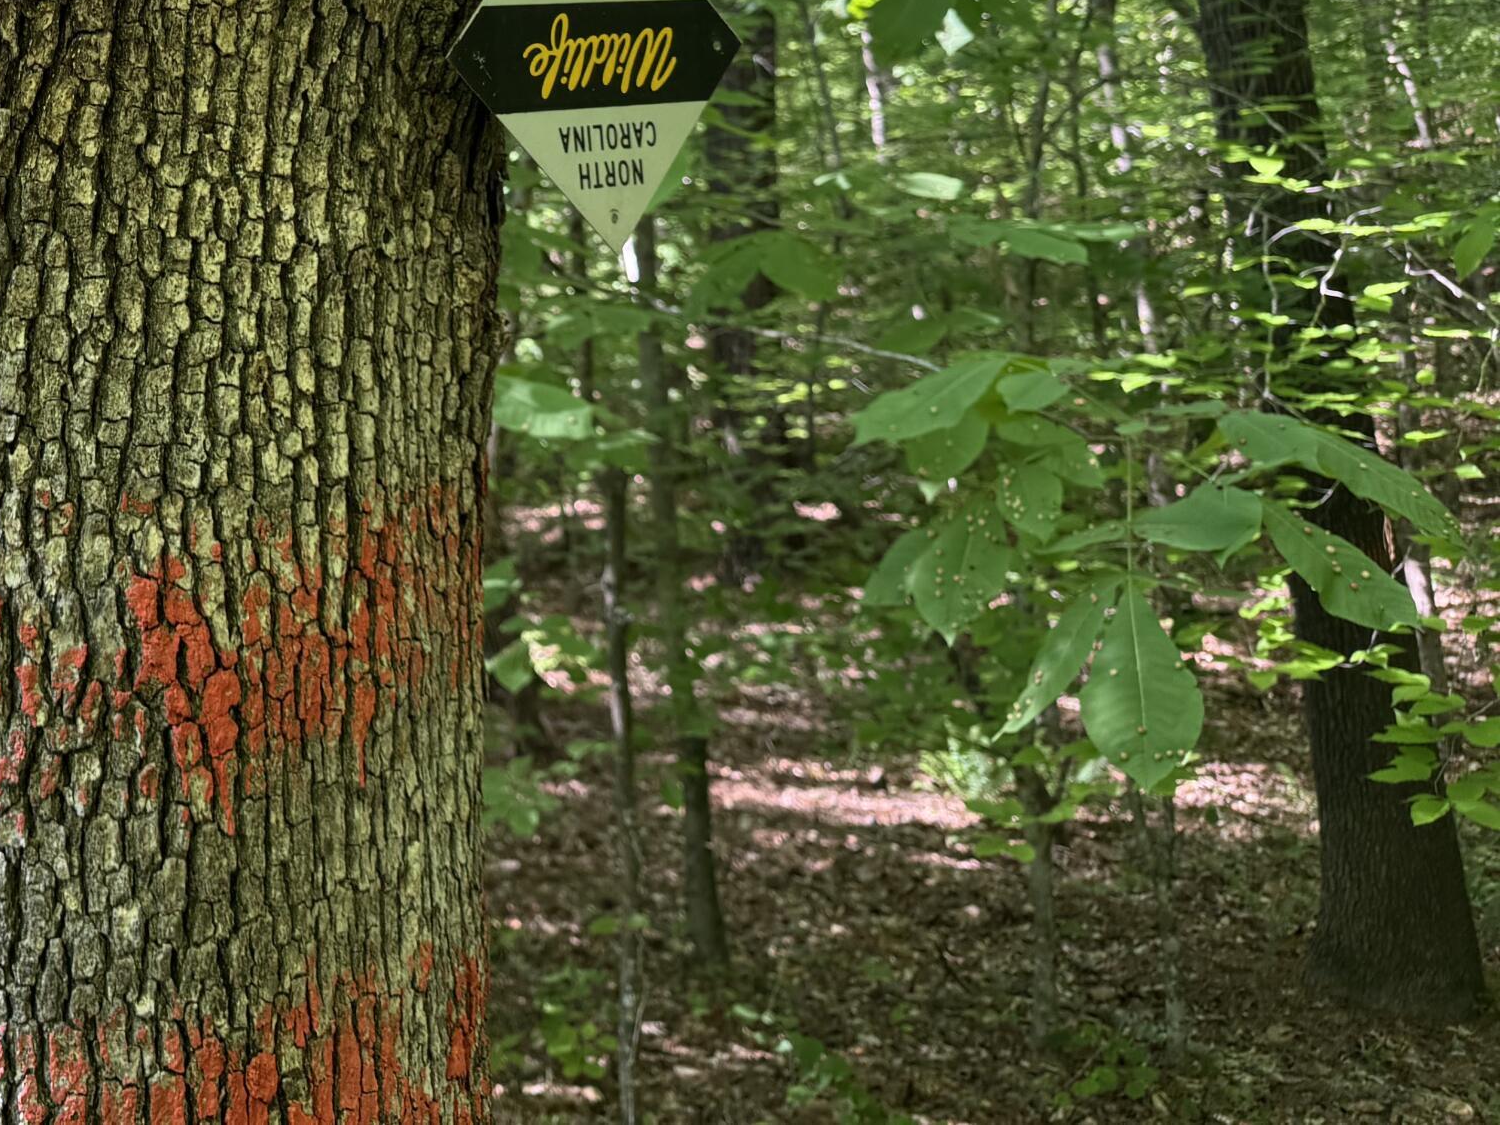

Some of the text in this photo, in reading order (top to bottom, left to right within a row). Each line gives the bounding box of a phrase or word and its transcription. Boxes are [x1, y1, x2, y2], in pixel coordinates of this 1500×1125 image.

[523, 13, 676, 99] Wildlife
[559, 121, 657, 154] CAROLINA
[579, 159, 644, 189] NORTH
